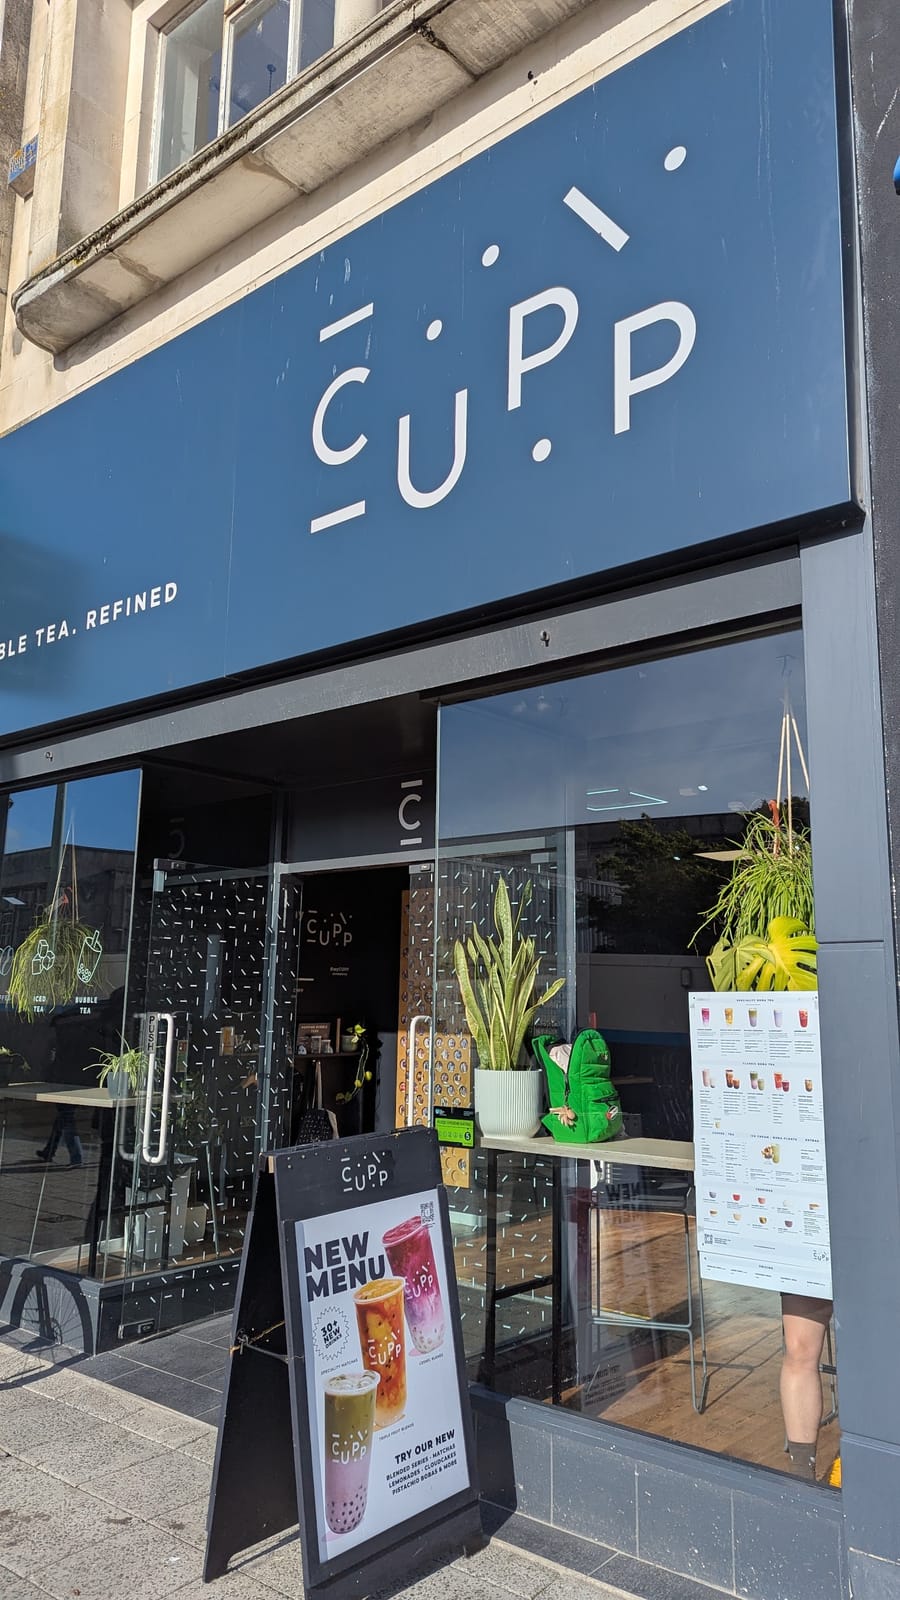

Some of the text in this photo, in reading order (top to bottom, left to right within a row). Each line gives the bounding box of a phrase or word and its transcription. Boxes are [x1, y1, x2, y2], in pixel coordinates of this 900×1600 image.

[311, 286, 697, 509] CUPP
[35, 620, 77, 647] TEA.
[86, 582, 178, 630] REFINED
[307, 919, 353, 947] CUPP
[33, 995, 47, 1003] ICED
[33, 1005, 44, 1013] TEA
[75, 996, 98, 1004] BUBBLE
[147, 1015, 156, 1051] PUSH
[342, 1164, 388, 1191] CUPP
[304, 1231, 370, 1274] NEW
[306, 1254, 386, 1303] MENU
[320, 1320, 338, 1337] 30+
[323, 1326, 340, 1344] NEW
[368, 1342, 402, 1365] CUPP
[332, 1441, 367, 1465] CUPP
[386, 1443, 456, 1481] BLENDED SERIES MATCHAS
[394, 1428, 455, 1465] TRY OUR NEW
[388, 1451, 457, 1488] LEMONADES CLOUDCAKES
[391, 1478, 420, 1496] PISTACHIO
[420, 1469, 438, 1482] BOBAS
[443, 1459, 458, 1469] MORE
